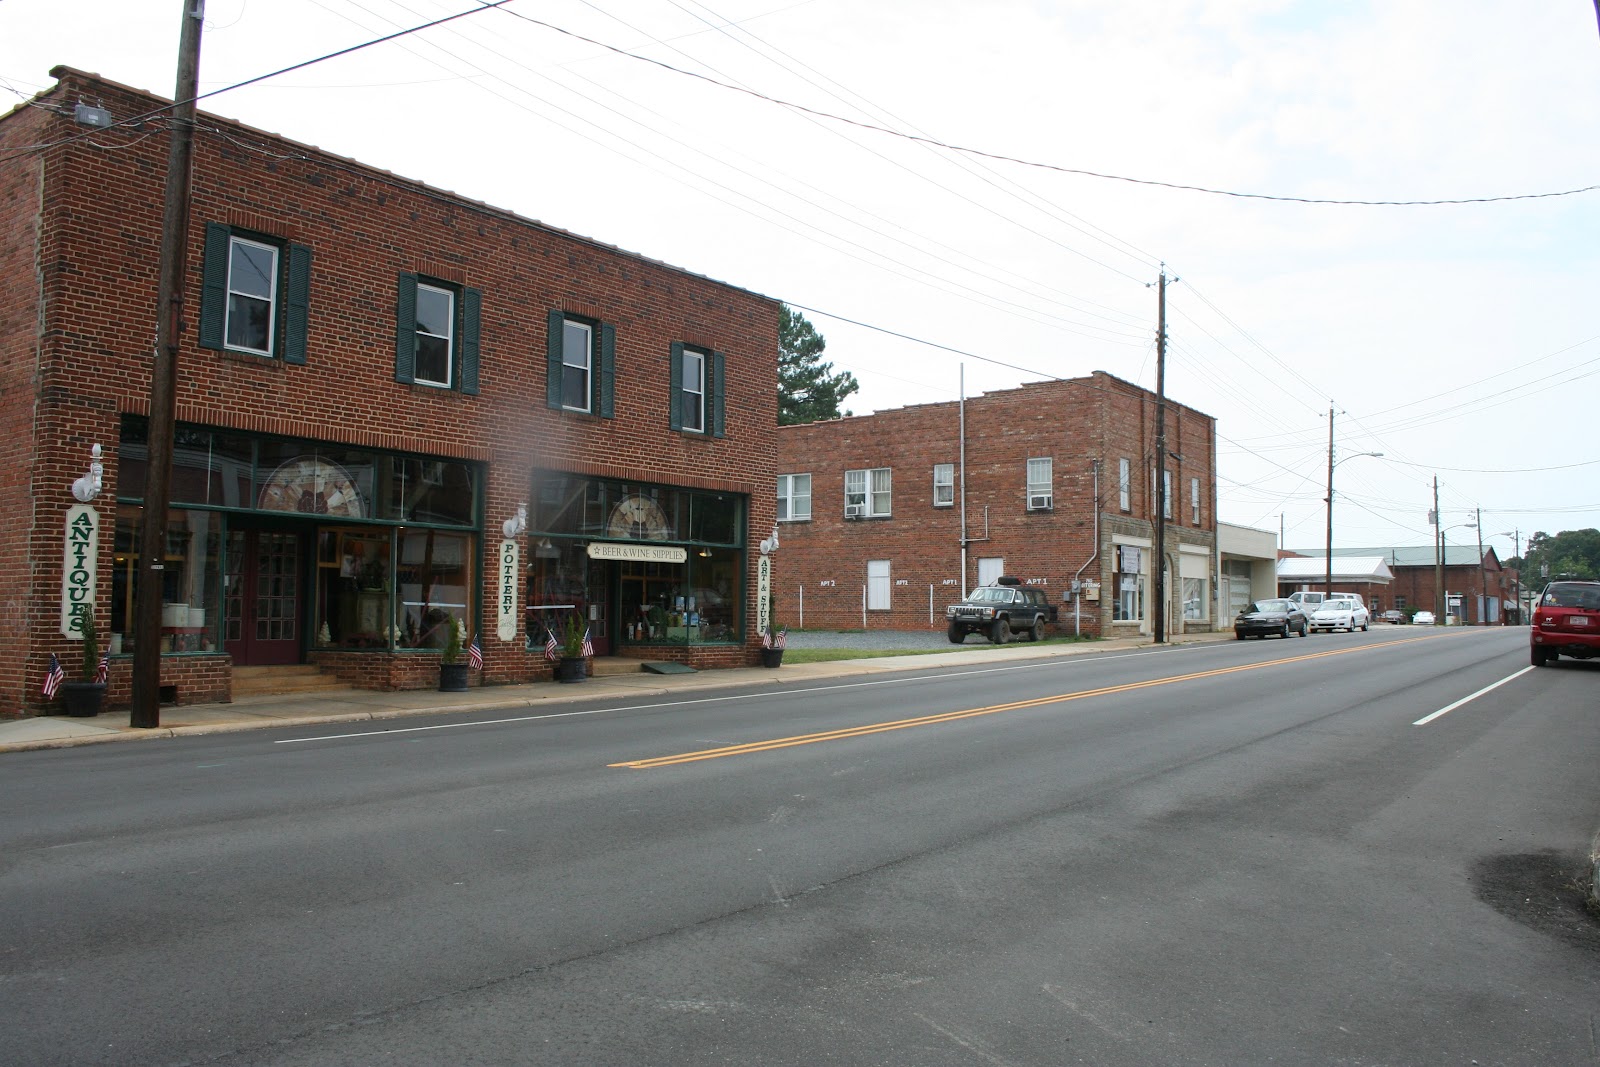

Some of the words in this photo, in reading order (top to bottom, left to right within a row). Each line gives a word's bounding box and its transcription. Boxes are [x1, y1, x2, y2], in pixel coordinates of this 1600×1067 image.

[68, 512, 94, 632] ANTIQUES
[652, 549, 684, 560] SUPPLIES
[502, 544, 514, 614] POTTERY
[761, 584, 767, 592] &
